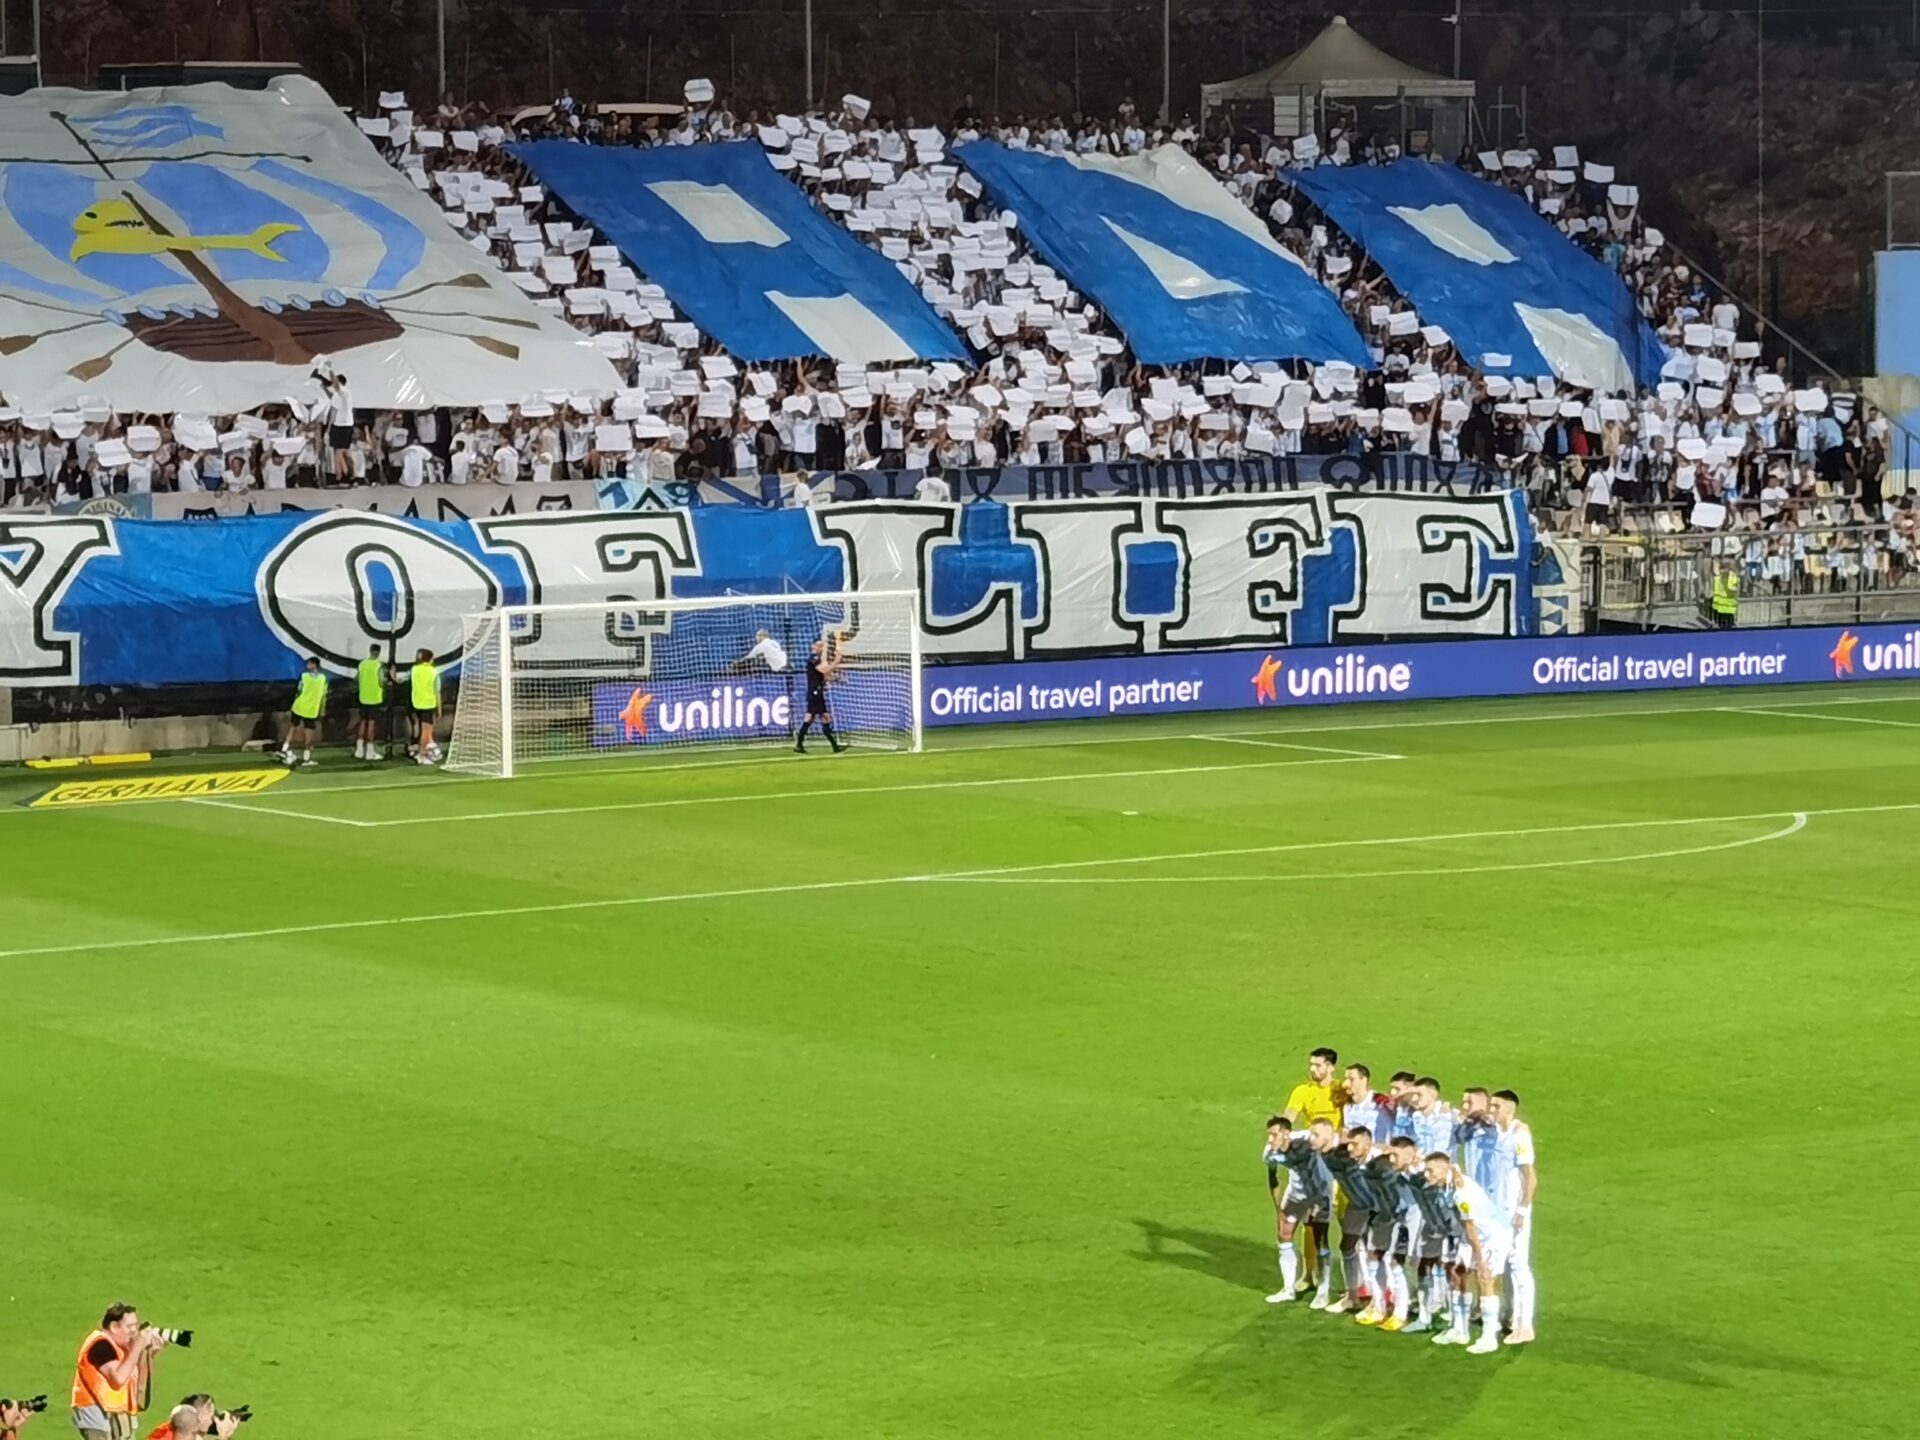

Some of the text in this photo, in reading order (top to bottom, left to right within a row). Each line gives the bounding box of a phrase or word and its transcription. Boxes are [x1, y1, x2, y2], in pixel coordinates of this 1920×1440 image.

[257, 507, 702, 680] OF
[806, 489, 1519, 661] LIFE
[1288, 653, 1412, 697] uniline
[1533, 651, 1787, 684] Official travel partner
[658, 686, 790, 733] uniline
[930, 678, 1204, 716] Official travel partner
[50, 774, 268, 802] GERMANIA
